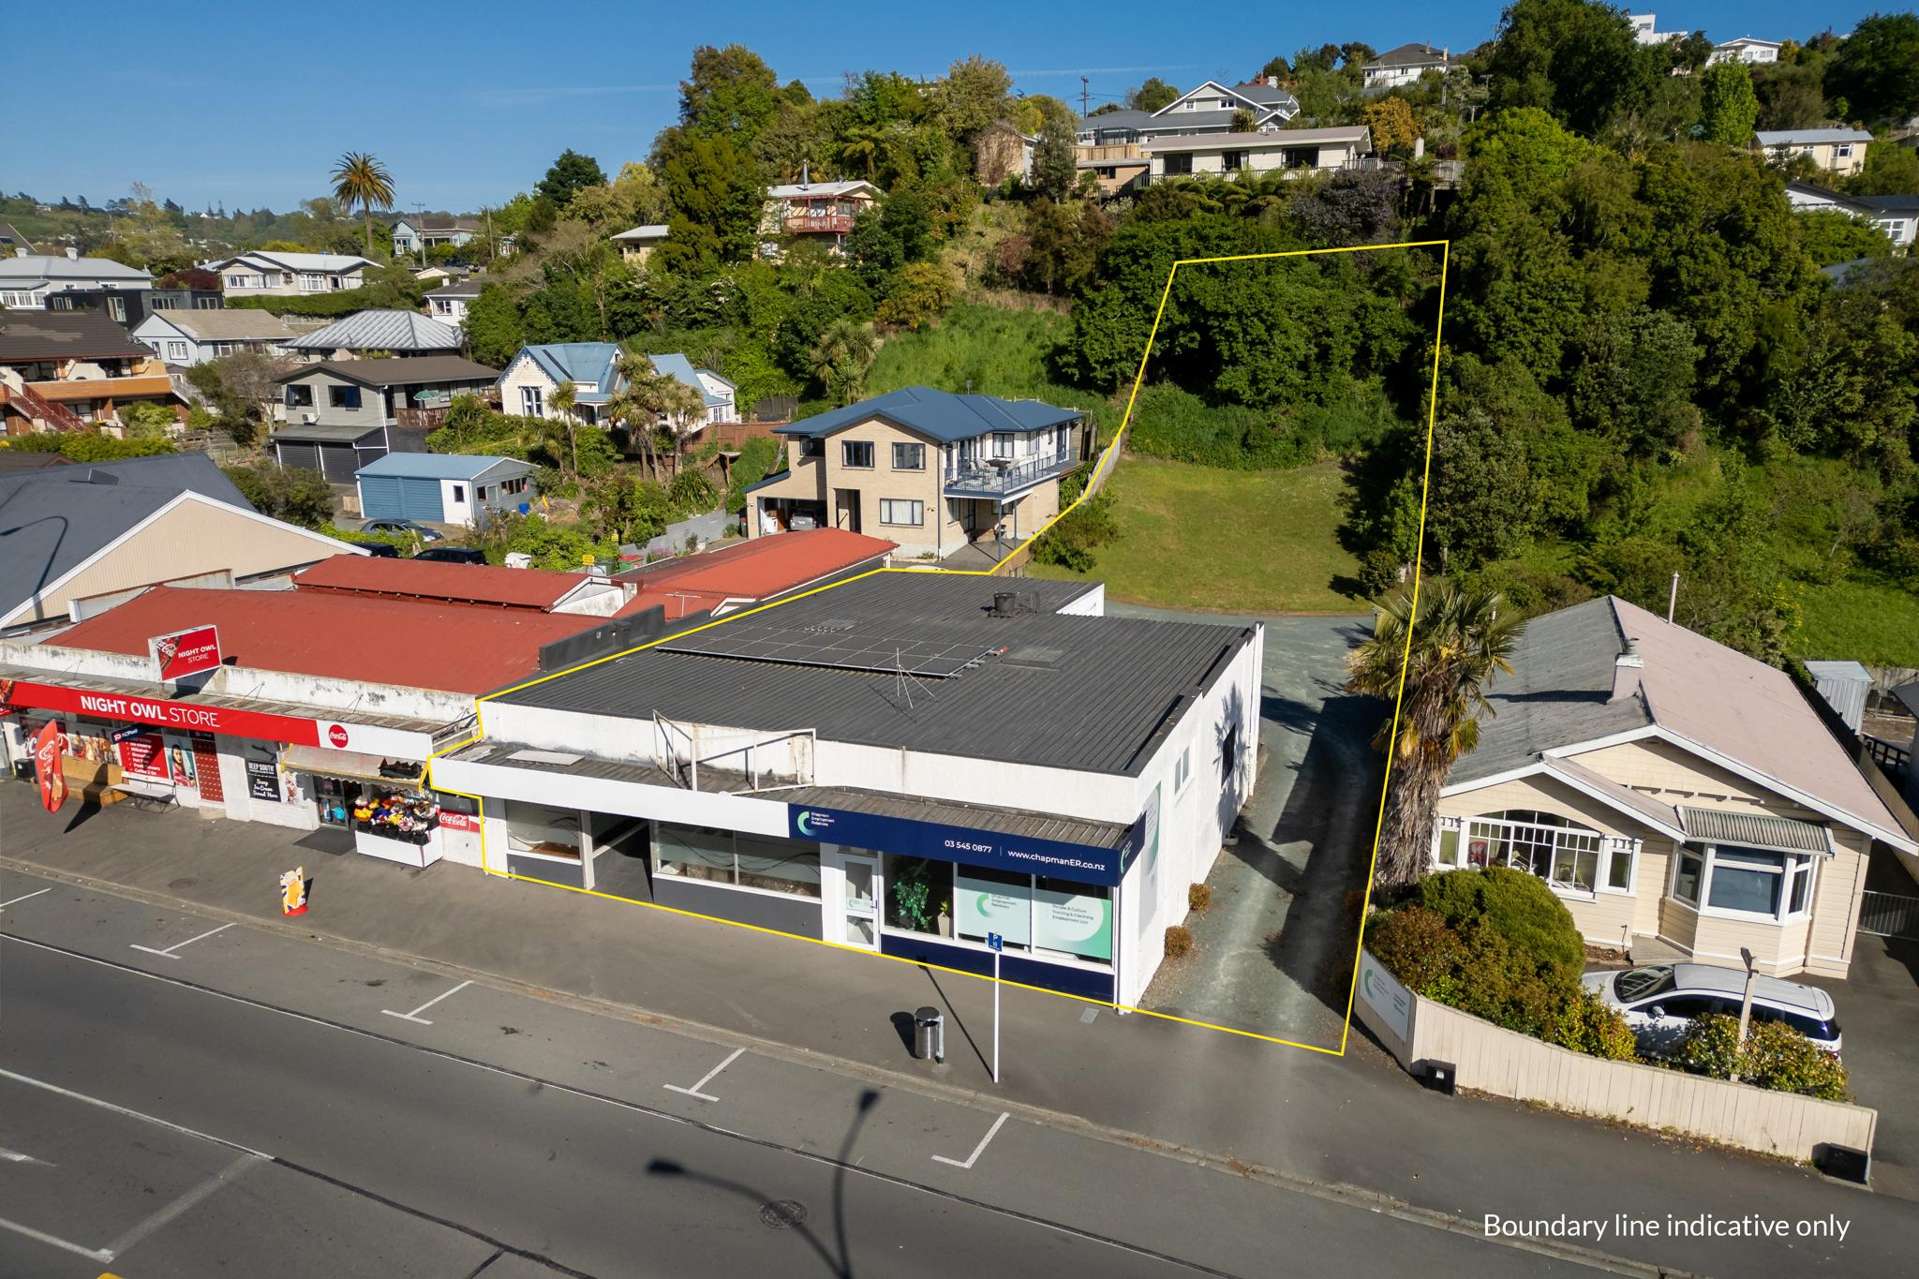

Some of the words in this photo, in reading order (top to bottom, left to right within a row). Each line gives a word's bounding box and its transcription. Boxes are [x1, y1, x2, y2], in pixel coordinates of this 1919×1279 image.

[178, 648, 199, 658] NIGHT
[200, 644, 216, 652] OWL
[187, 653, 209, 663] STORE
[80, 696, 126, 714] NIGHT
[131, 703, 167, 720] OWL
[169, 707, 220, 727] STORE
[944, 839, 955, 848] 03
[956, 841, 971, 850] 545
[972, 843, 993, 853] 0877
[1007, 849, 1106, 871] www.chapmanER.co.nz
